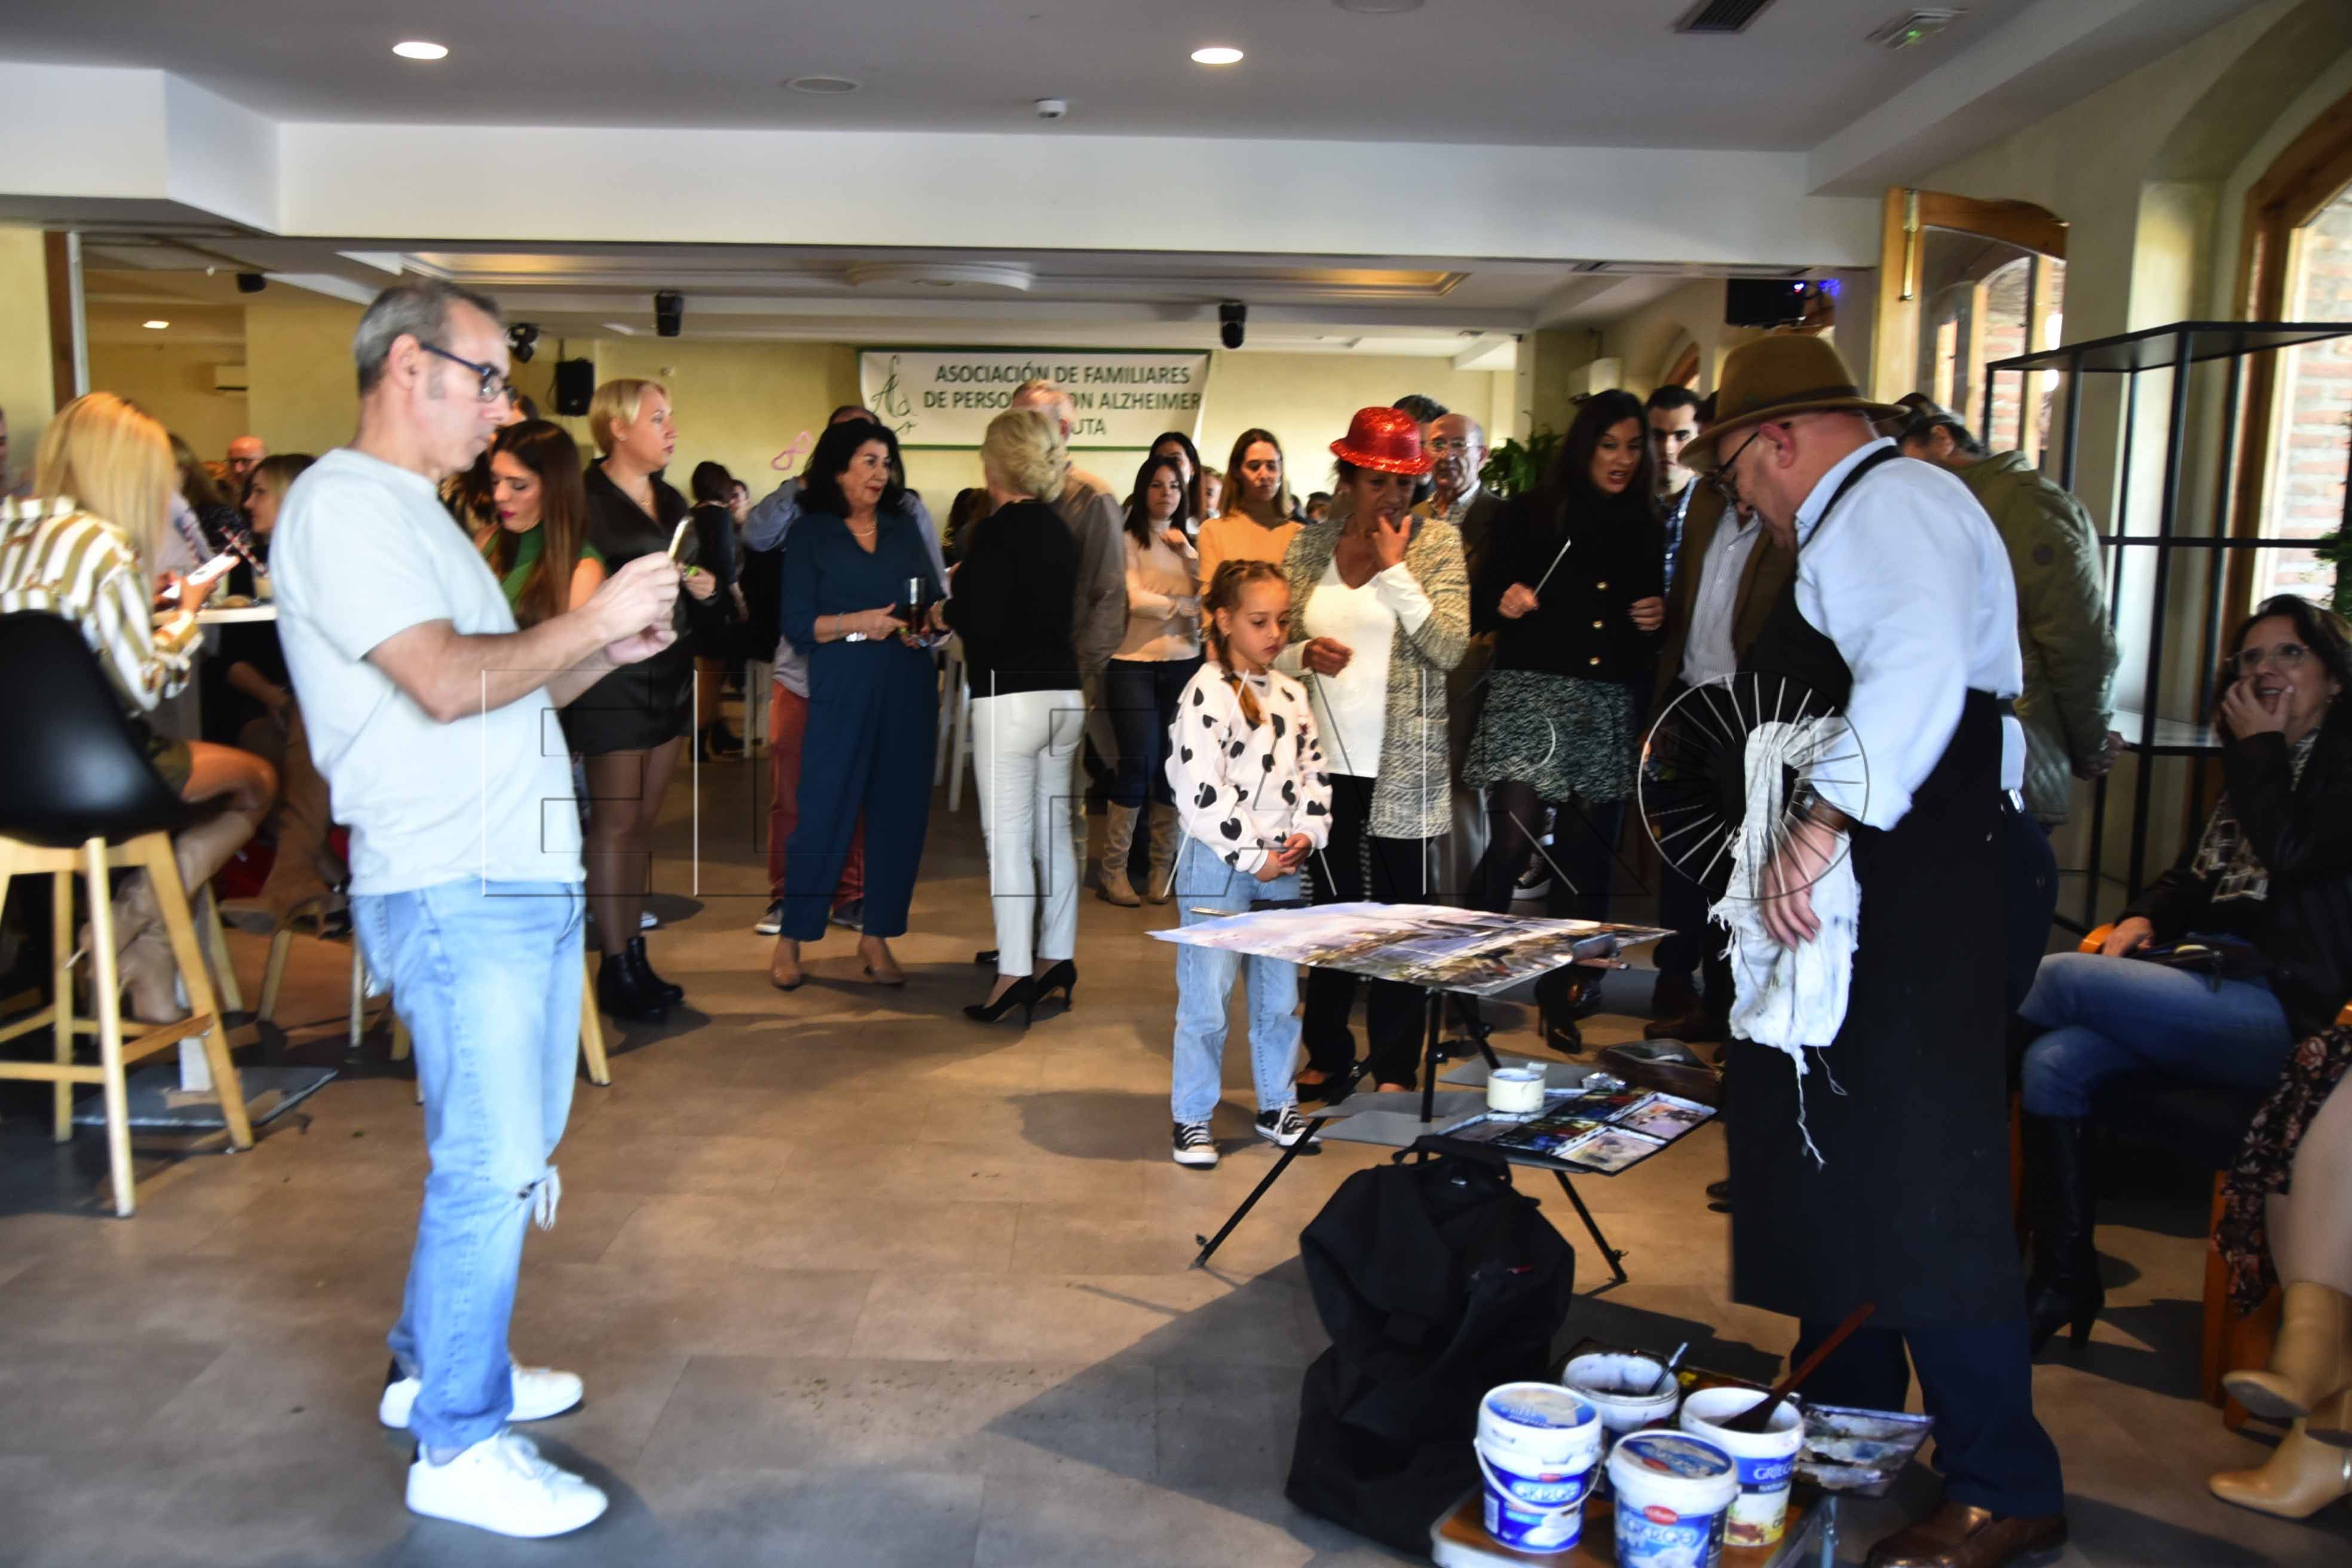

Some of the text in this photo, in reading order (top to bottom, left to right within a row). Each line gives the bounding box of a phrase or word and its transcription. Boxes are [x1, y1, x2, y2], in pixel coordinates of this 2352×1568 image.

[935, 362, 1191, 384] ASOCIACIÓN DE FAMILIARES
[923, 391, 1201, 409] DE PERSO ON ALZHEIMER
[1071, 418, 1107, 435] UTA
